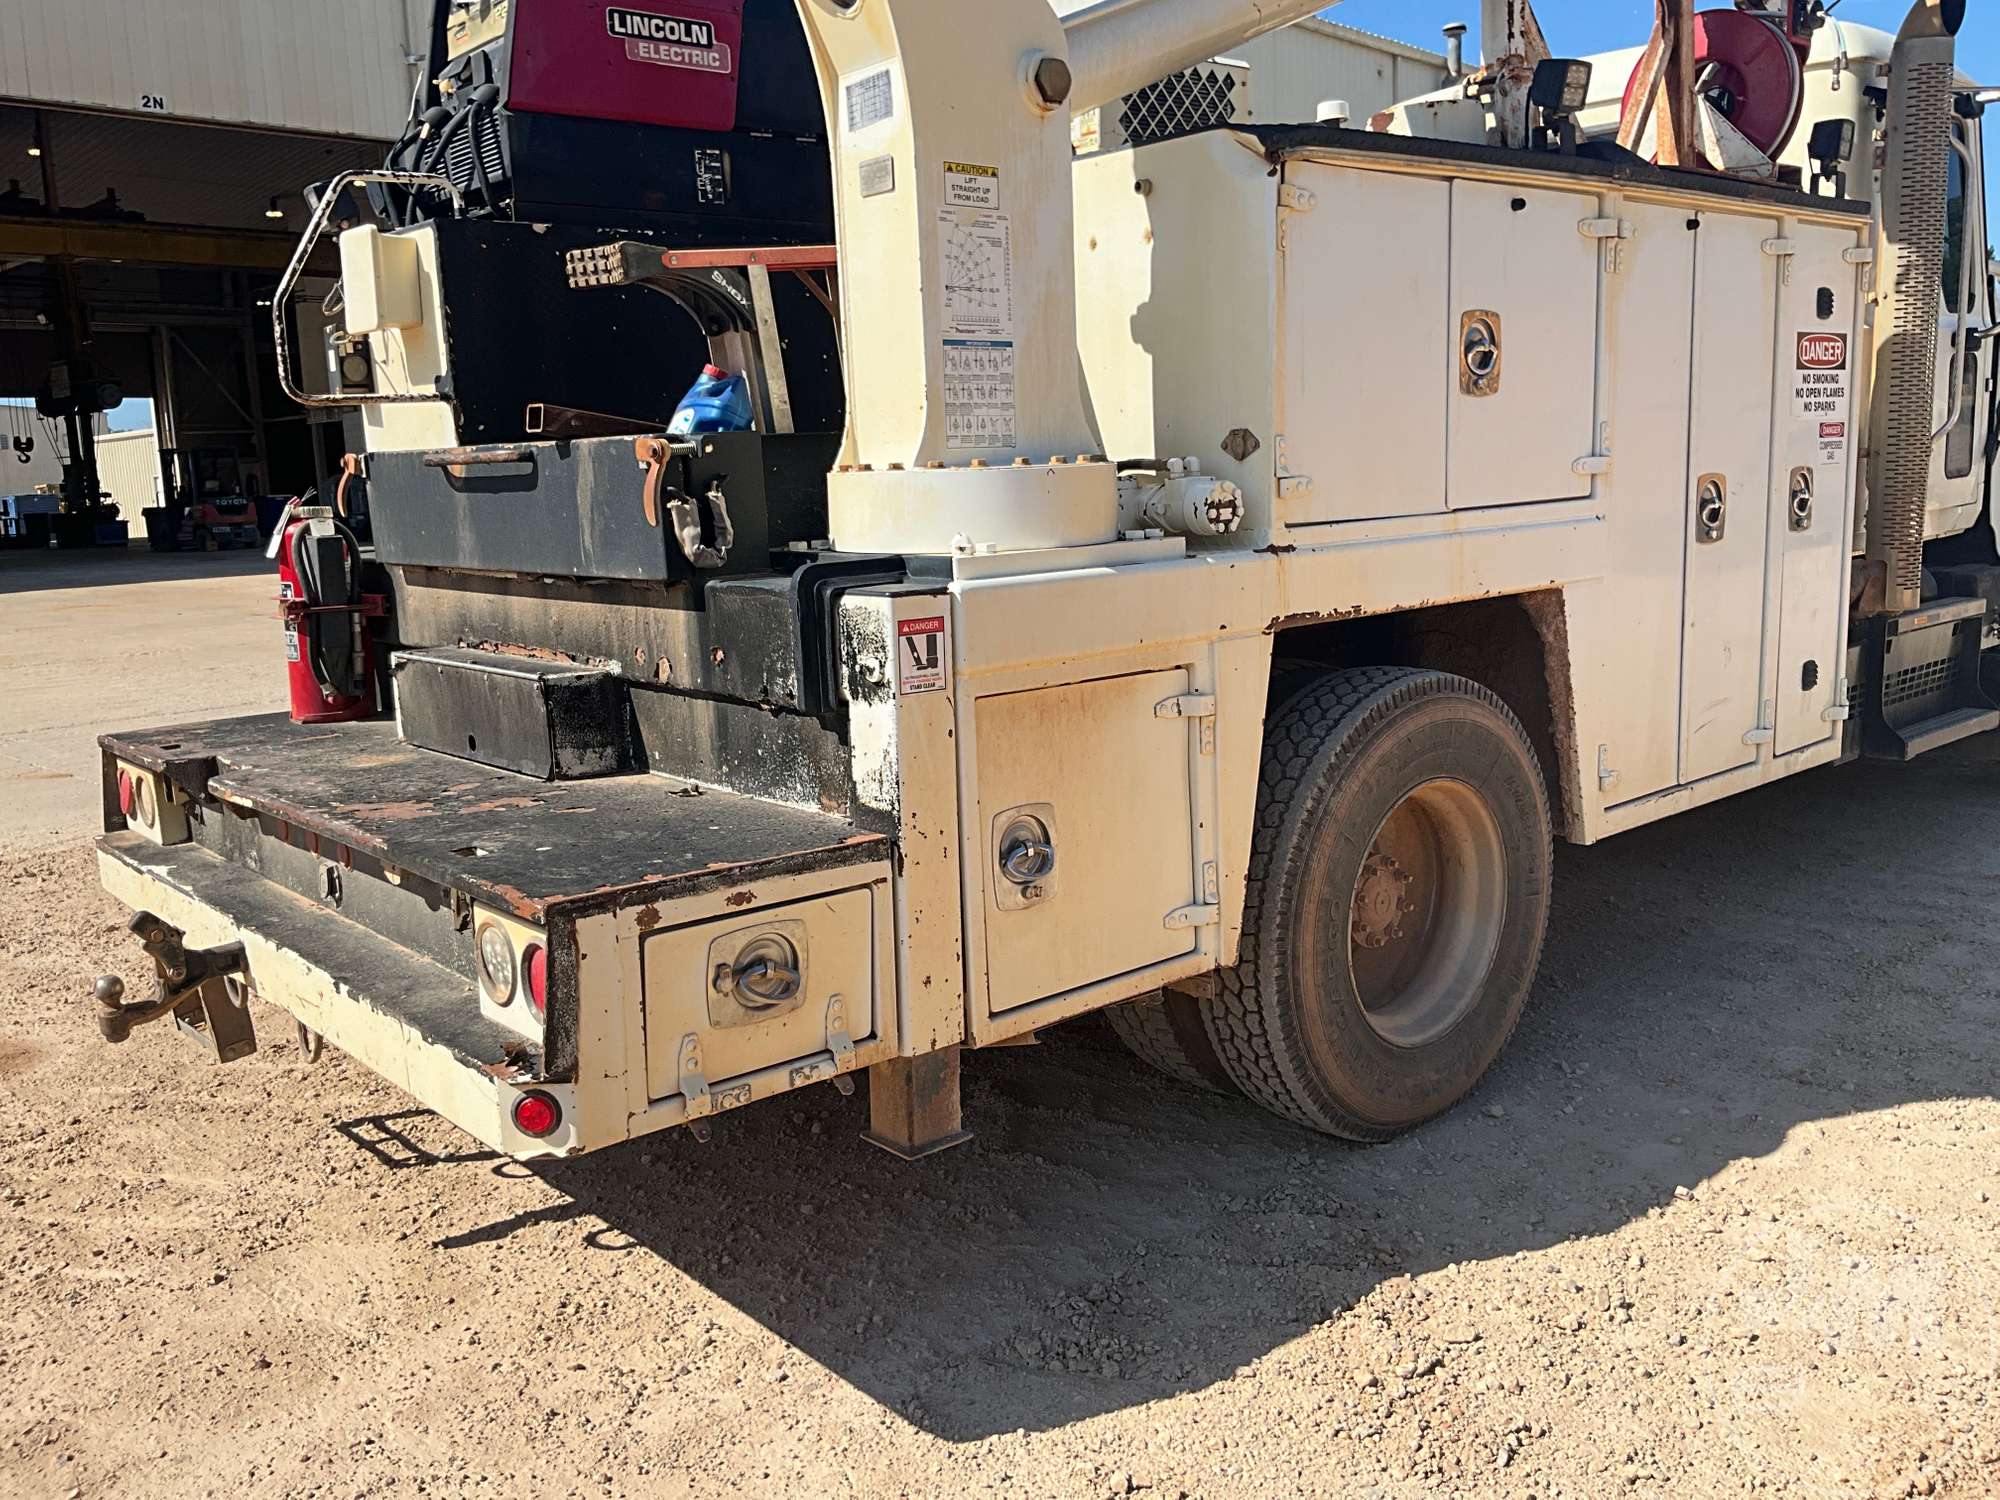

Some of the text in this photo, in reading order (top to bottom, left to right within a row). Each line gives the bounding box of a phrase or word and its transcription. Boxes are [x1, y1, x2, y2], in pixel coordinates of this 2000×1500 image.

[613, 12, 708, 45] LINCOLN
[639, 42, 720, 67] ELECTRIC
[142, 95, 164, 109] 2N
[955, 164, 989, 177] CAUTION
[951, 184, 981, 194] STRAIGHT
[953, 193, 989, 204] FROM LOAD
[1802, 341, 1841, 361] DANGER
[1802, 373, 1839, 384] NO SMOKING
[1795, 387, 1845, 399] NO OPEN FLAMES
[1803, 401, 1836, 412] NO SPARKS
[909, 620, 939, 632] DANGER
